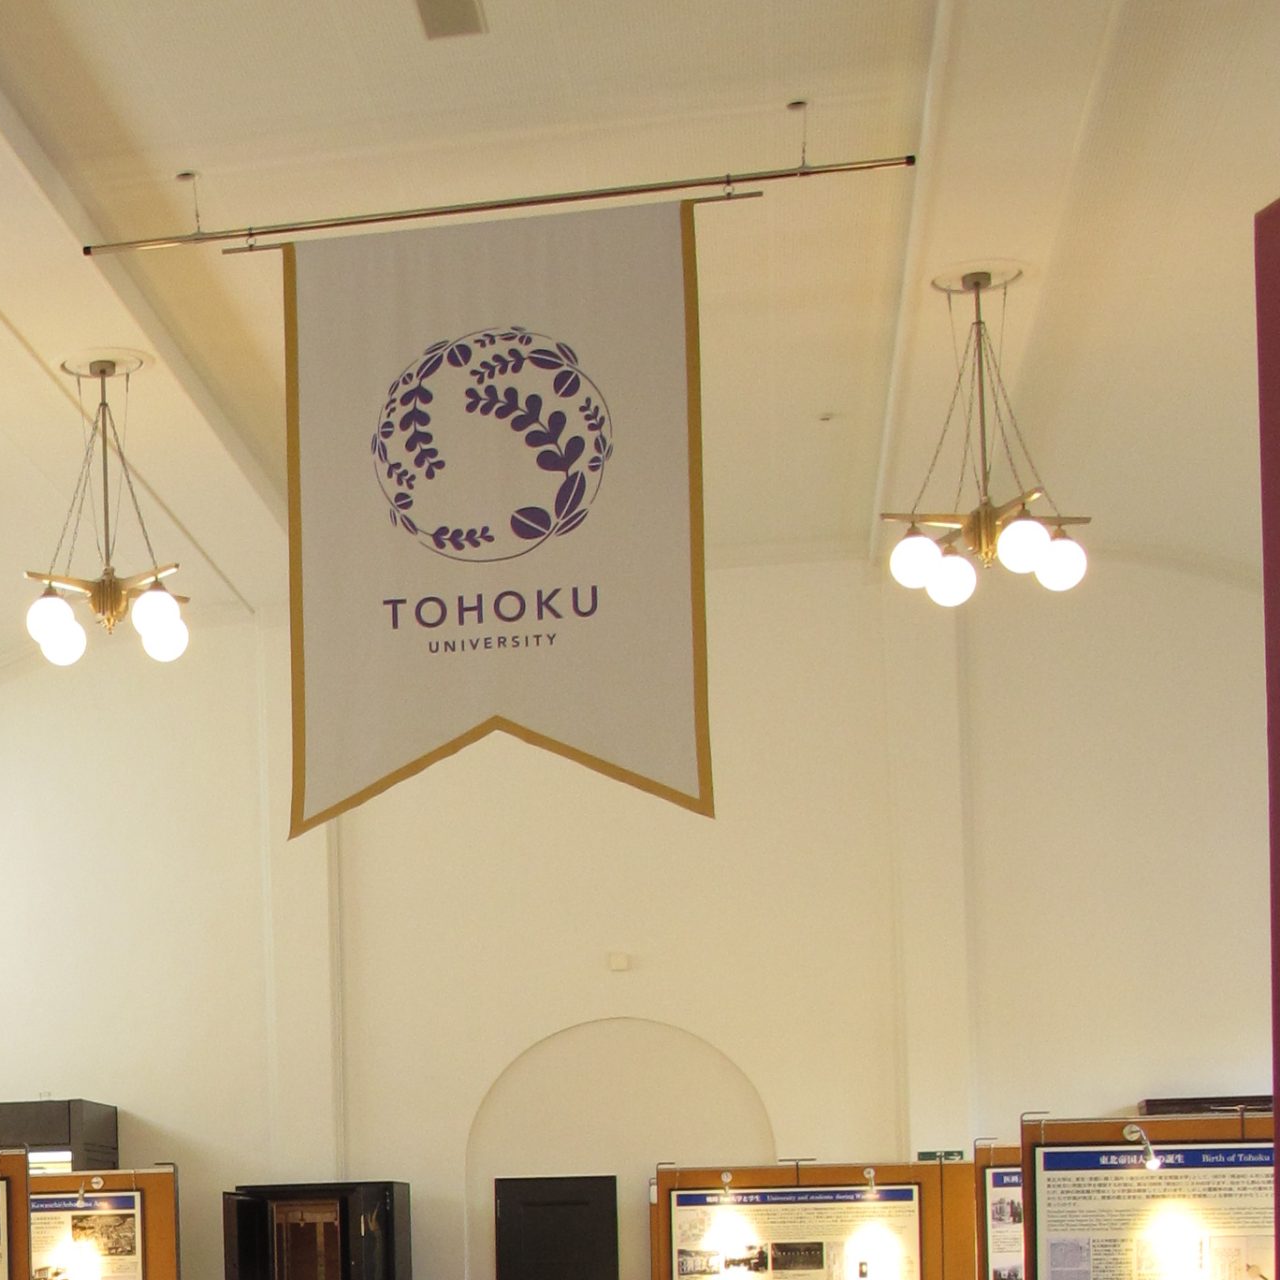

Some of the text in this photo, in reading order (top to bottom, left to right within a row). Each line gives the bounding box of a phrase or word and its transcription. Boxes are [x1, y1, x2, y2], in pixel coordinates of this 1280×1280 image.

[383, 585, 599, 629] TOHOKU
[429, 633, 558, 654] UNIVERSITY
[1100, 1154, 1184, 1165] 東北帝国大の誕生
[1202, 1154, 1225, 1162] Birth
[1226, 1154, 1235, 1162] of
[1237, 1153, 1270, 1161] Tohoku
